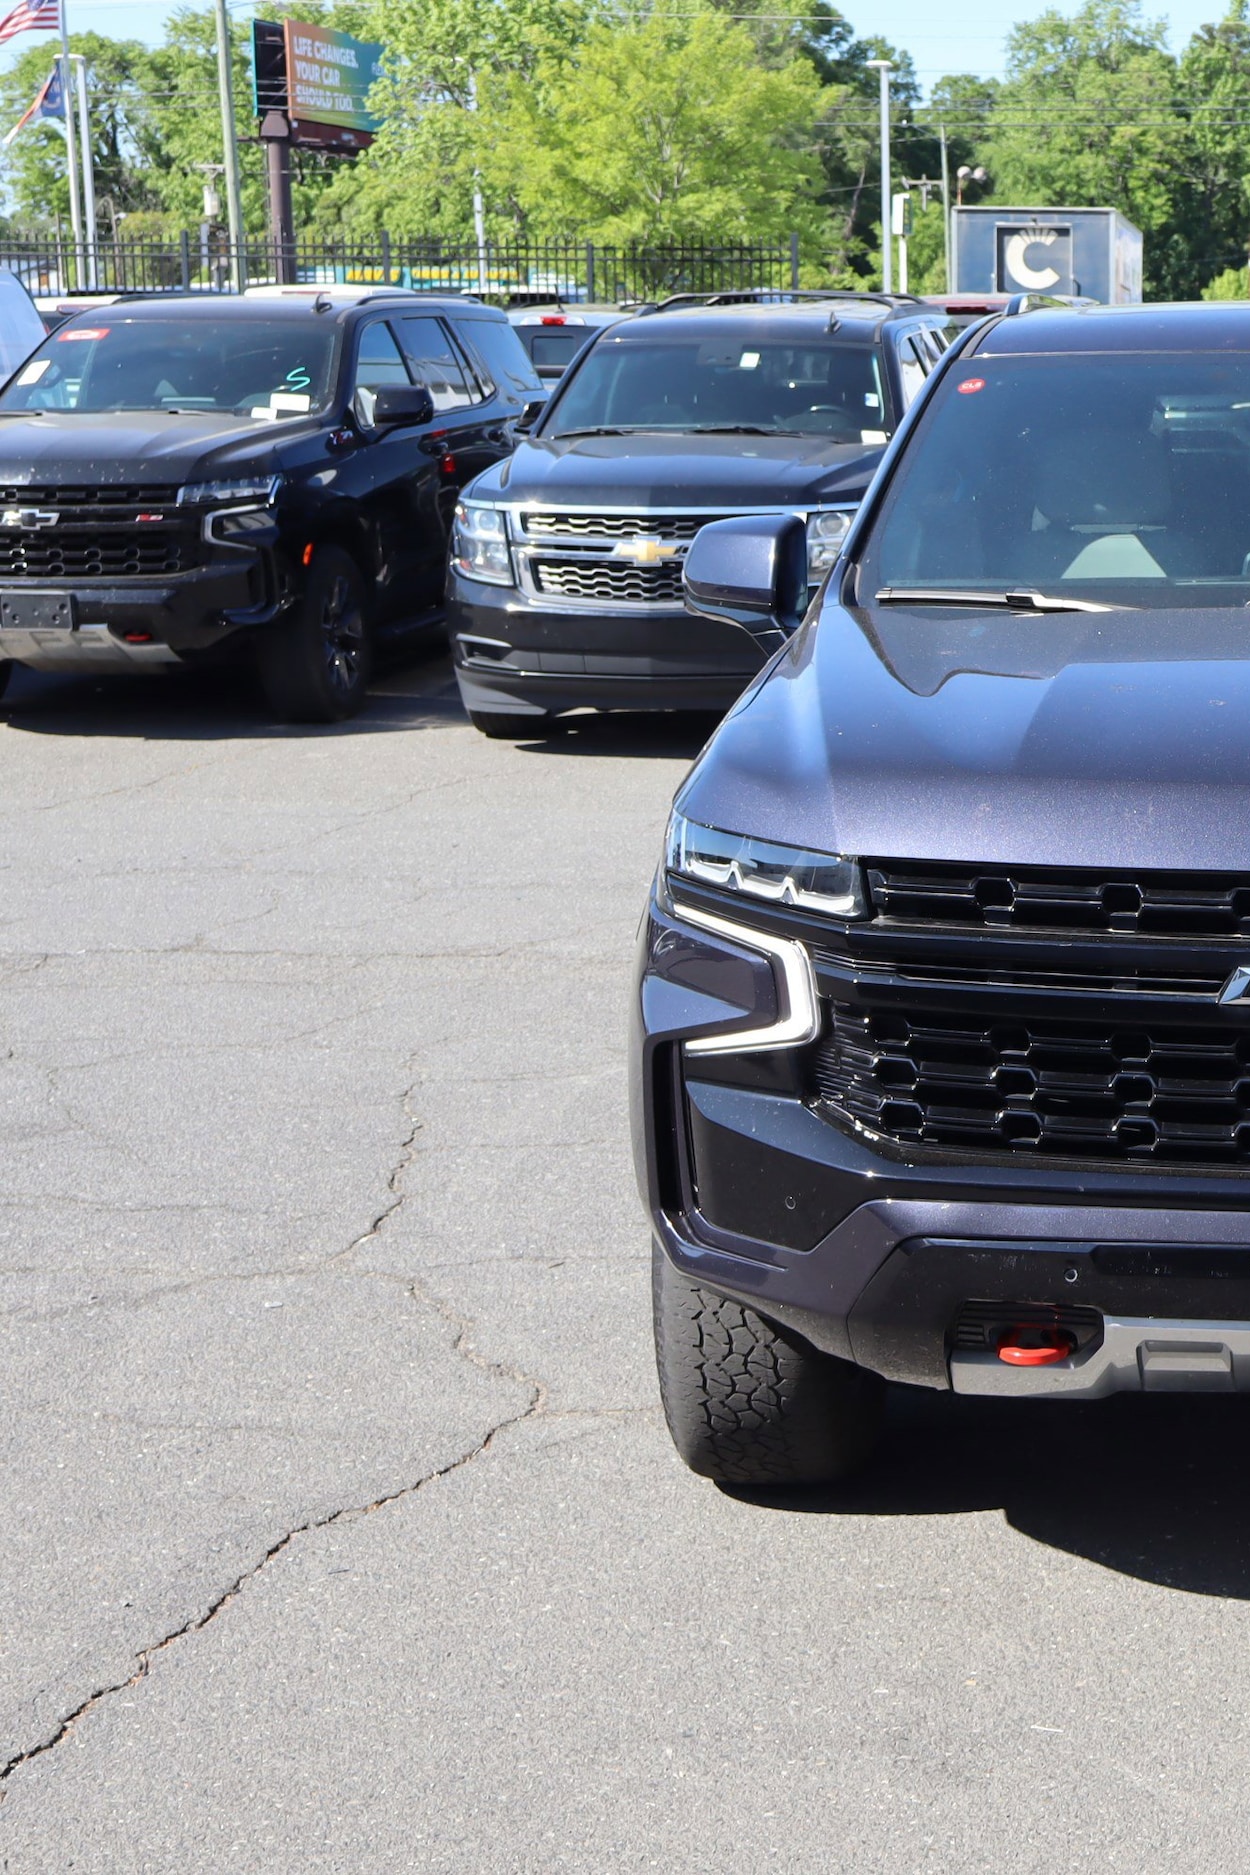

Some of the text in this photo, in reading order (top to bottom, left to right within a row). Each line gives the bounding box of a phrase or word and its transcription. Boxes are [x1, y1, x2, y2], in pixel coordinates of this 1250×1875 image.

[294, 36, 313, 57] LIFE
[294, 60, 341, 87] YOUR CAR
[295, 84, 333, 109] SHOULD
